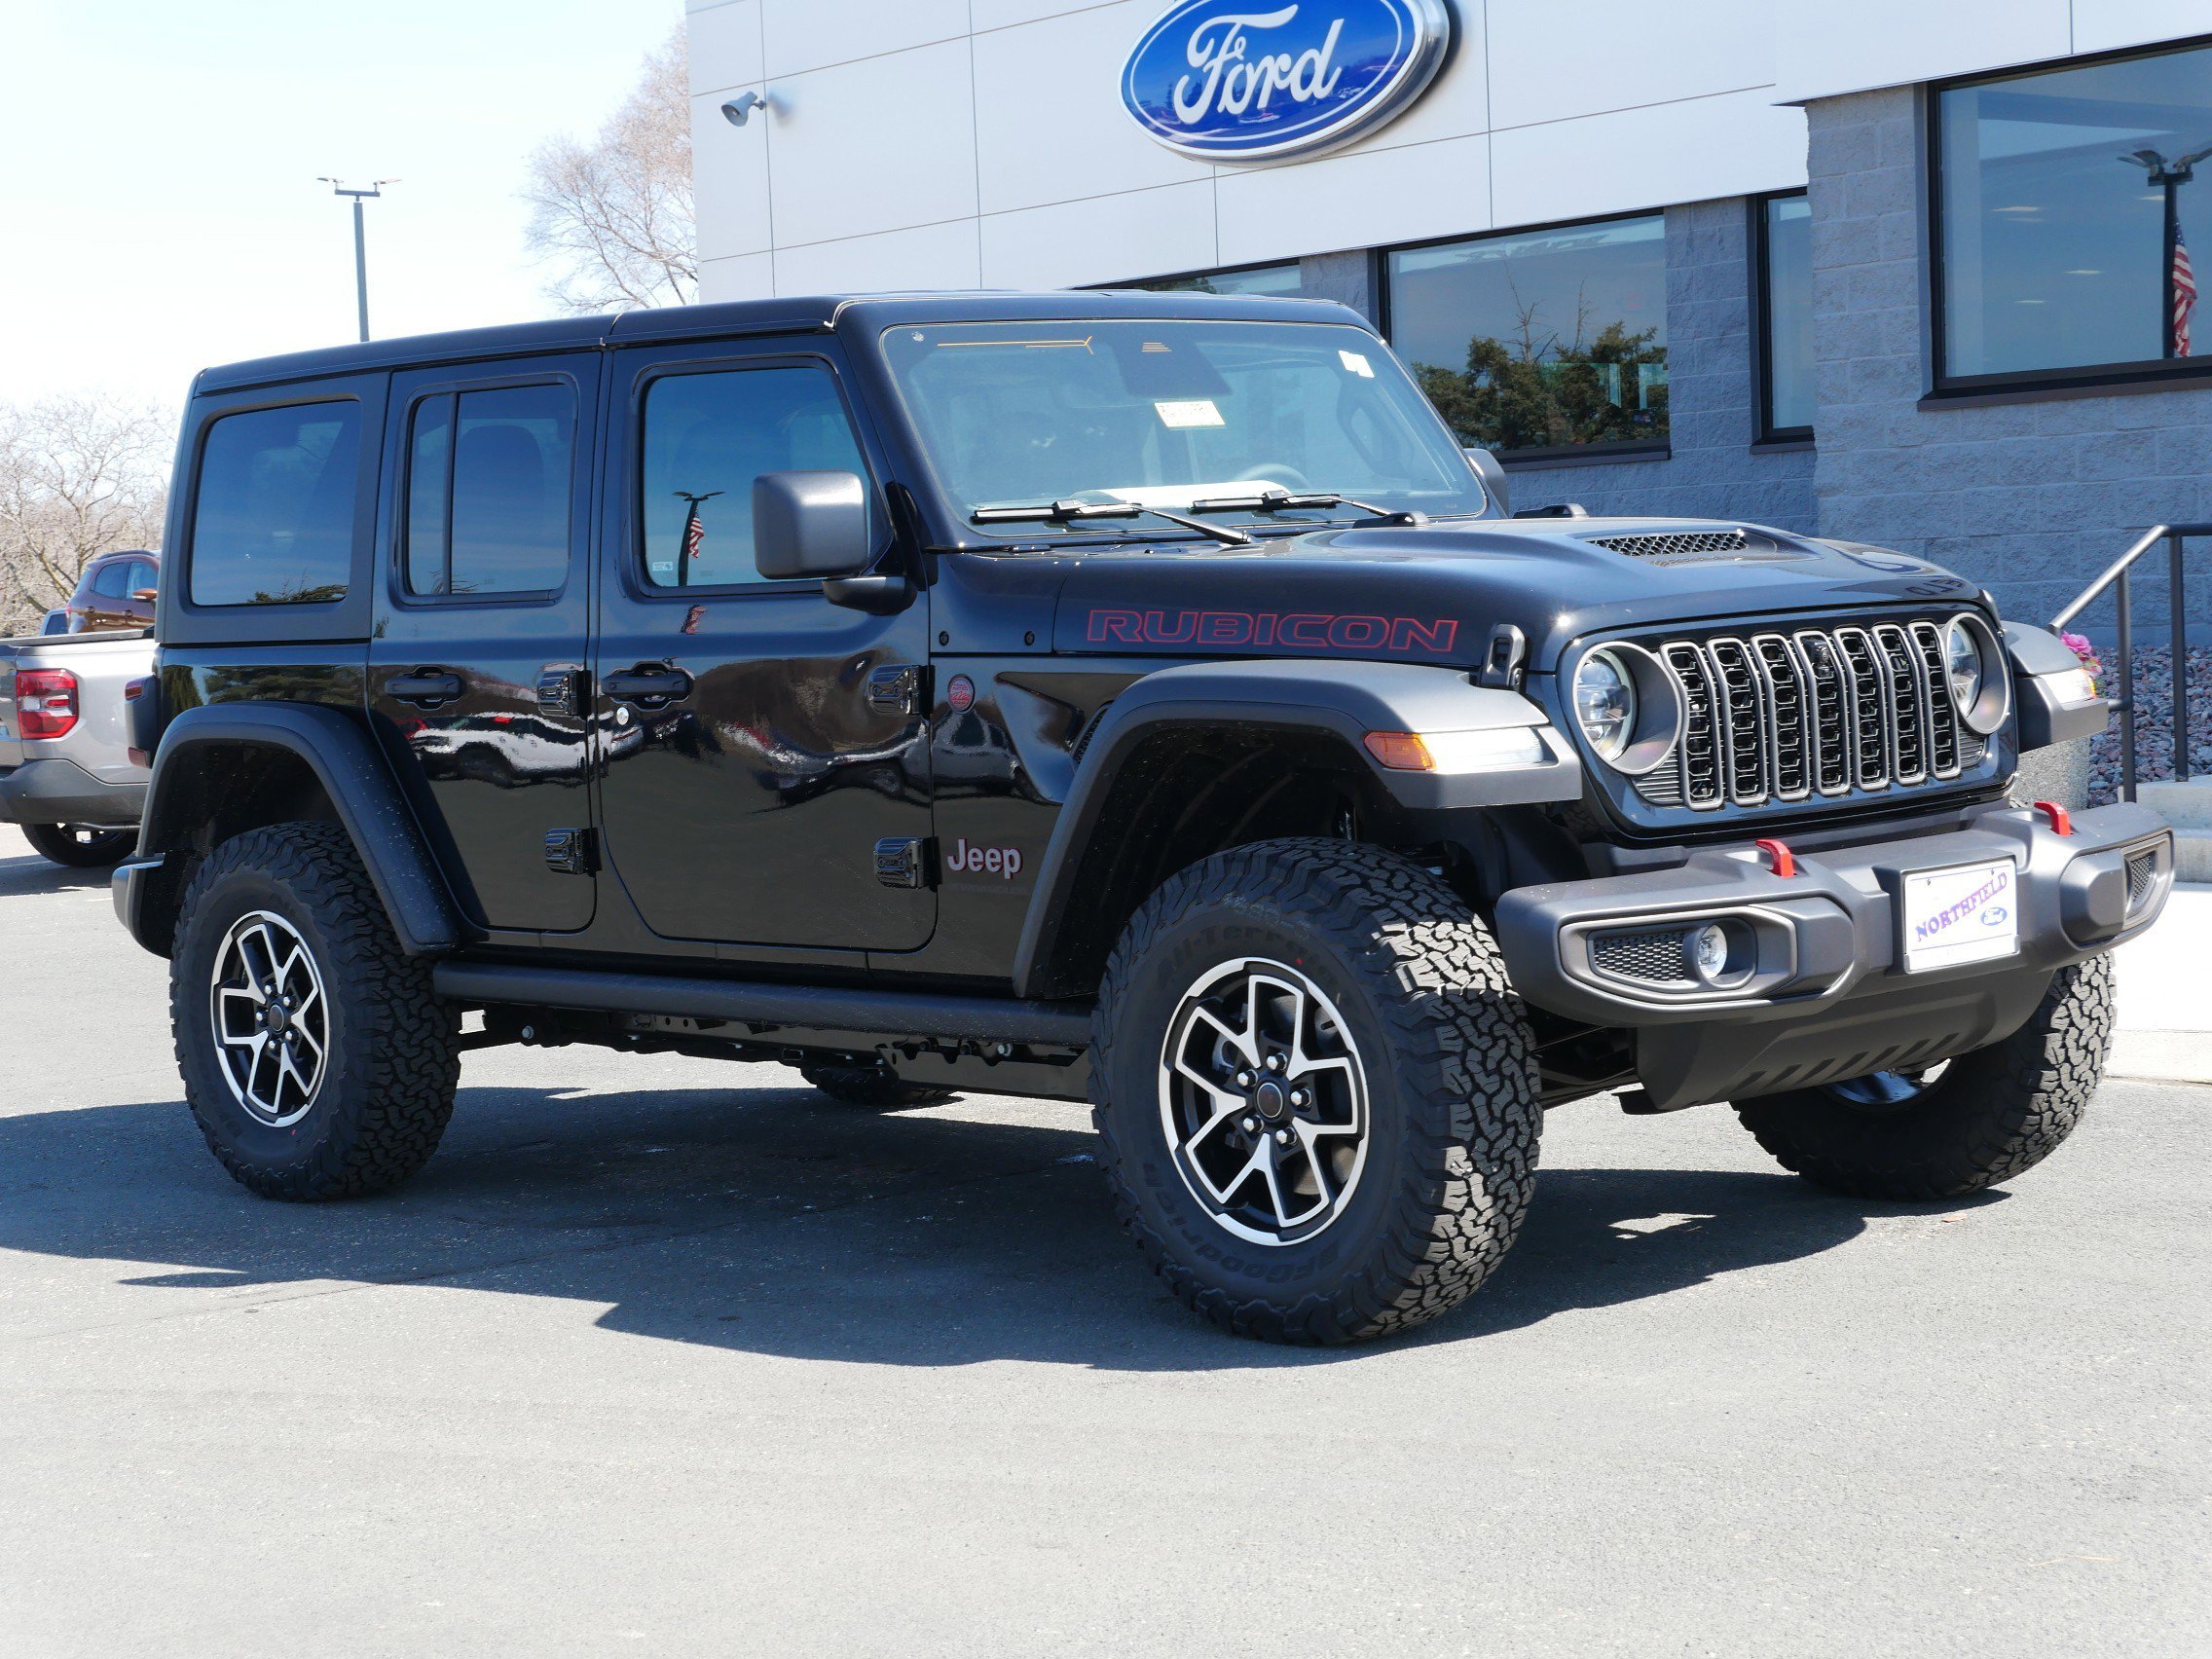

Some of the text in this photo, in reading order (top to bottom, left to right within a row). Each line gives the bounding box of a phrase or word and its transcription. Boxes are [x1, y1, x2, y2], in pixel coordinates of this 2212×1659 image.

[1173, 4, 1345, 124] Ford
[1087, 609, 1458, 652] RUBICON
[946, 838, 1022, 880] Jeep
[1915, 872, 2008, 942] NORTHFIELD
